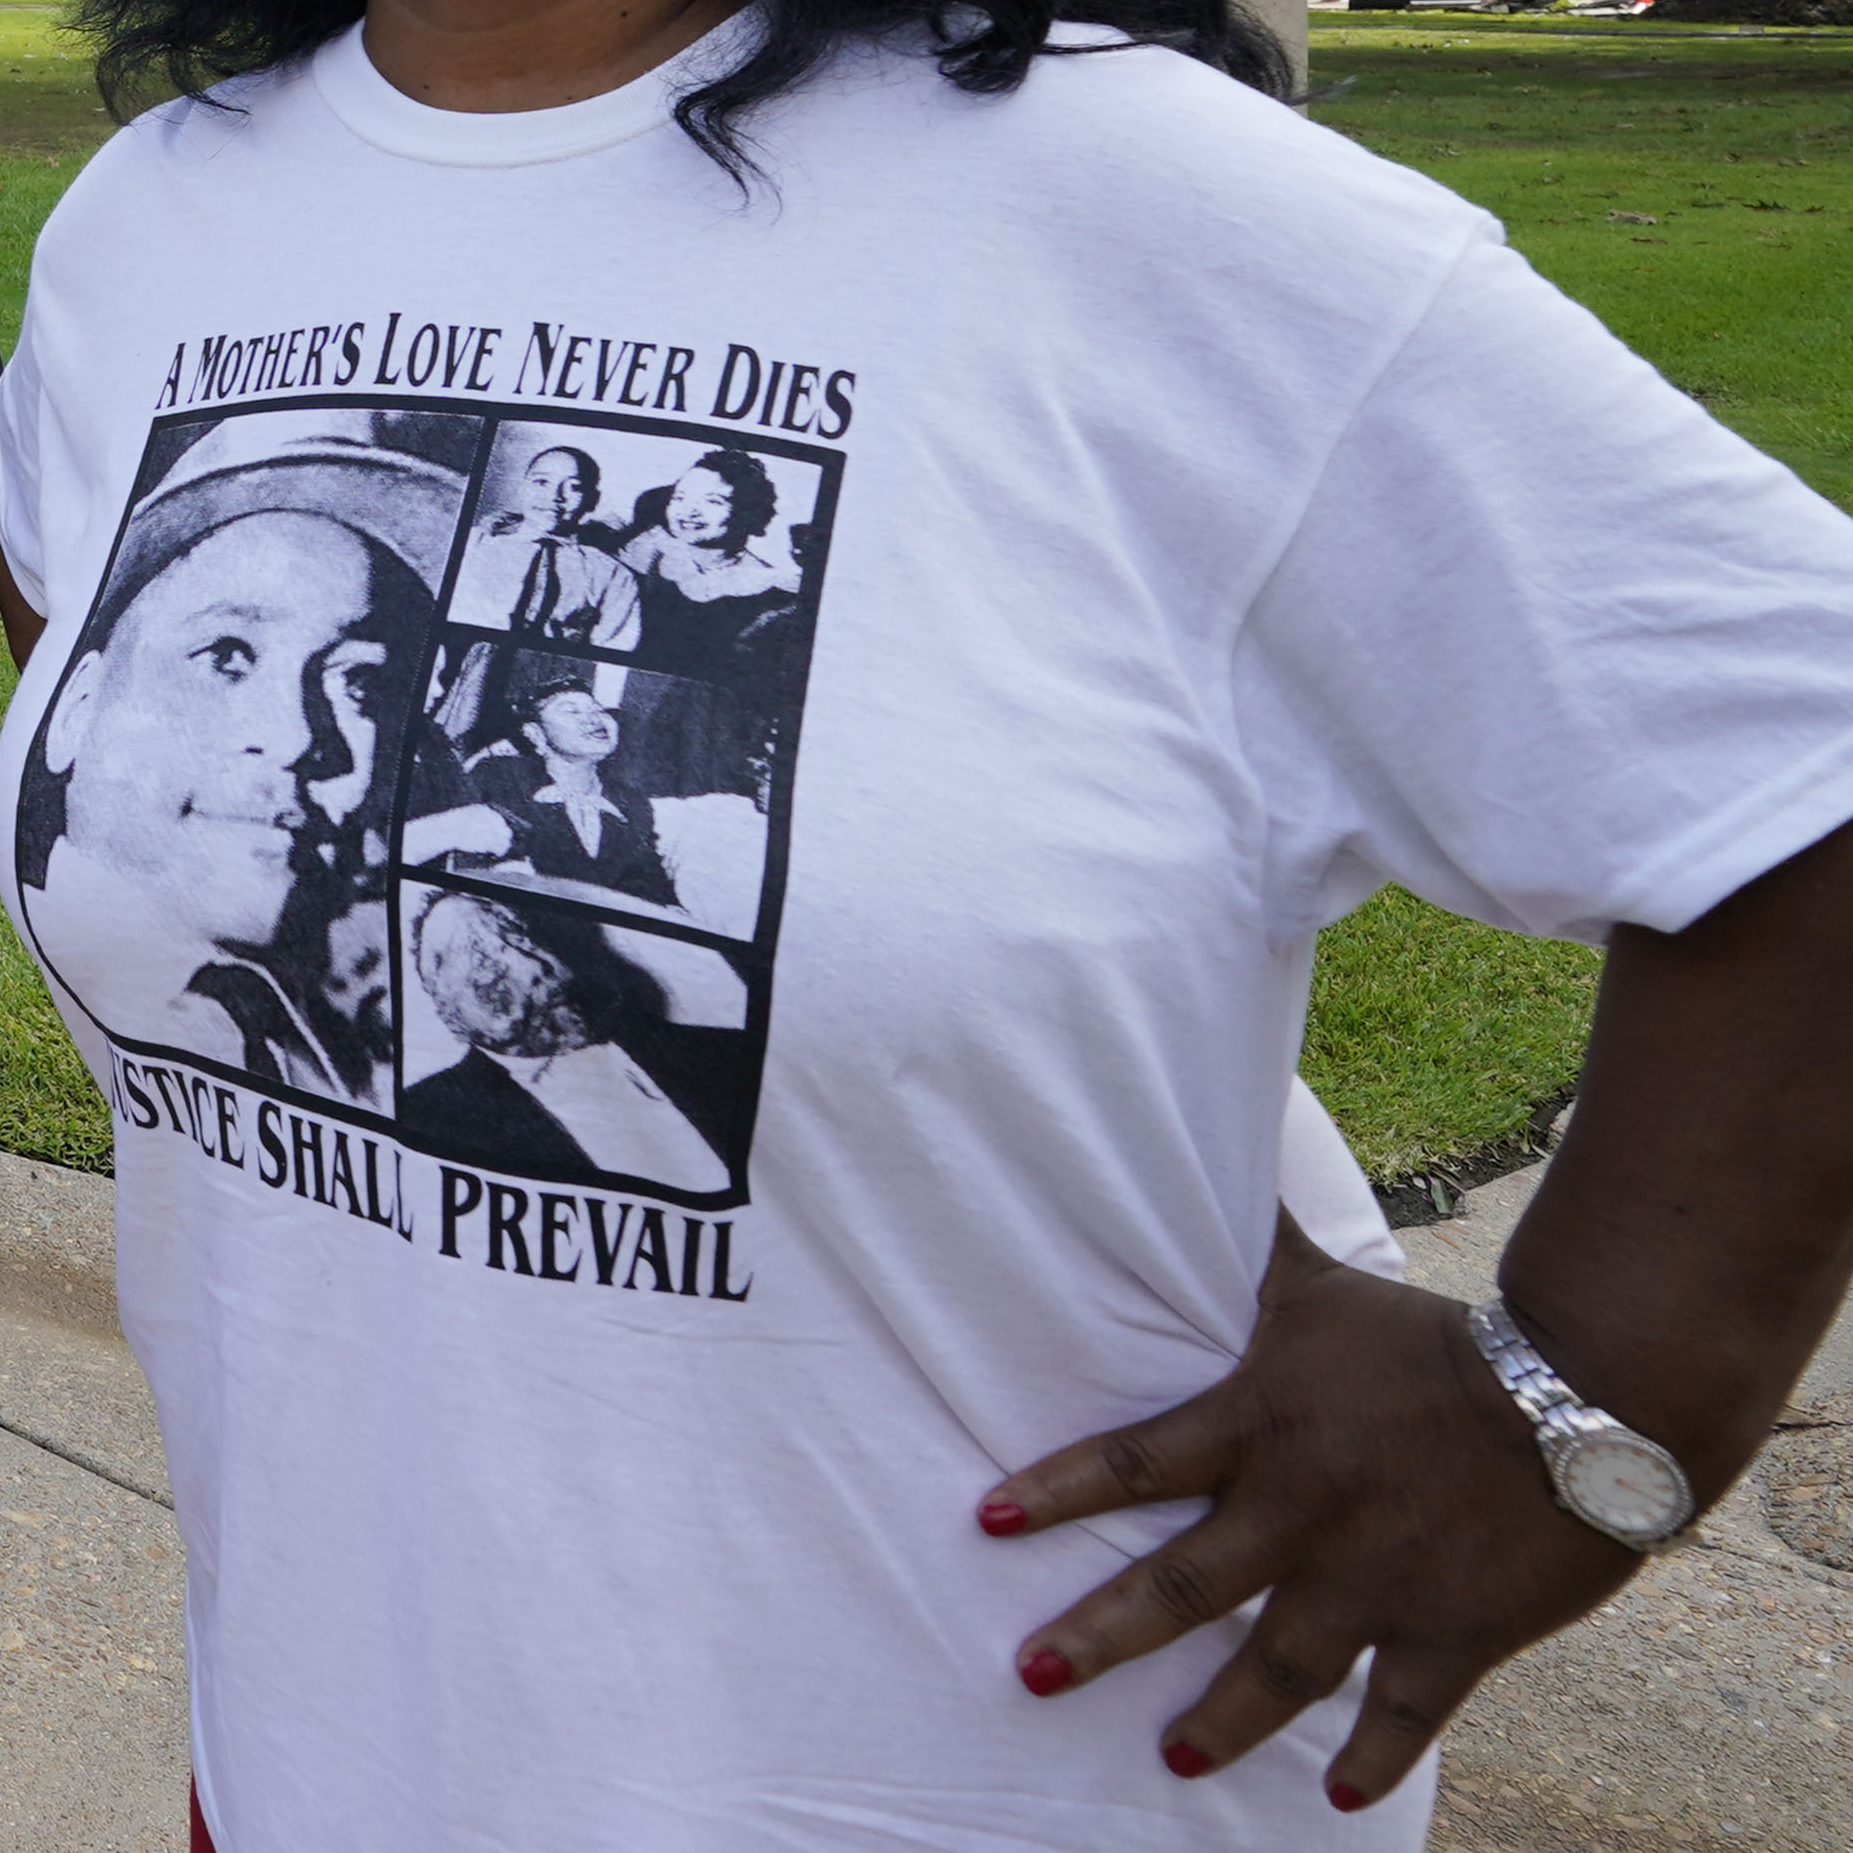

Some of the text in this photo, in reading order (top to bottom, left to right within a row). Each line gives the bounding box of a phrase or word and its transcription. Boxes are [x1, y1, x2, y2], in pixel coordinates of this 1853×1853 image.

[154, 312, 856, 440] A MOTHER'S LOVE NEVER DIES
[256, 1100, 414, 1243] SHALL
[438, 1164, 755, 1303] PREVAIL
